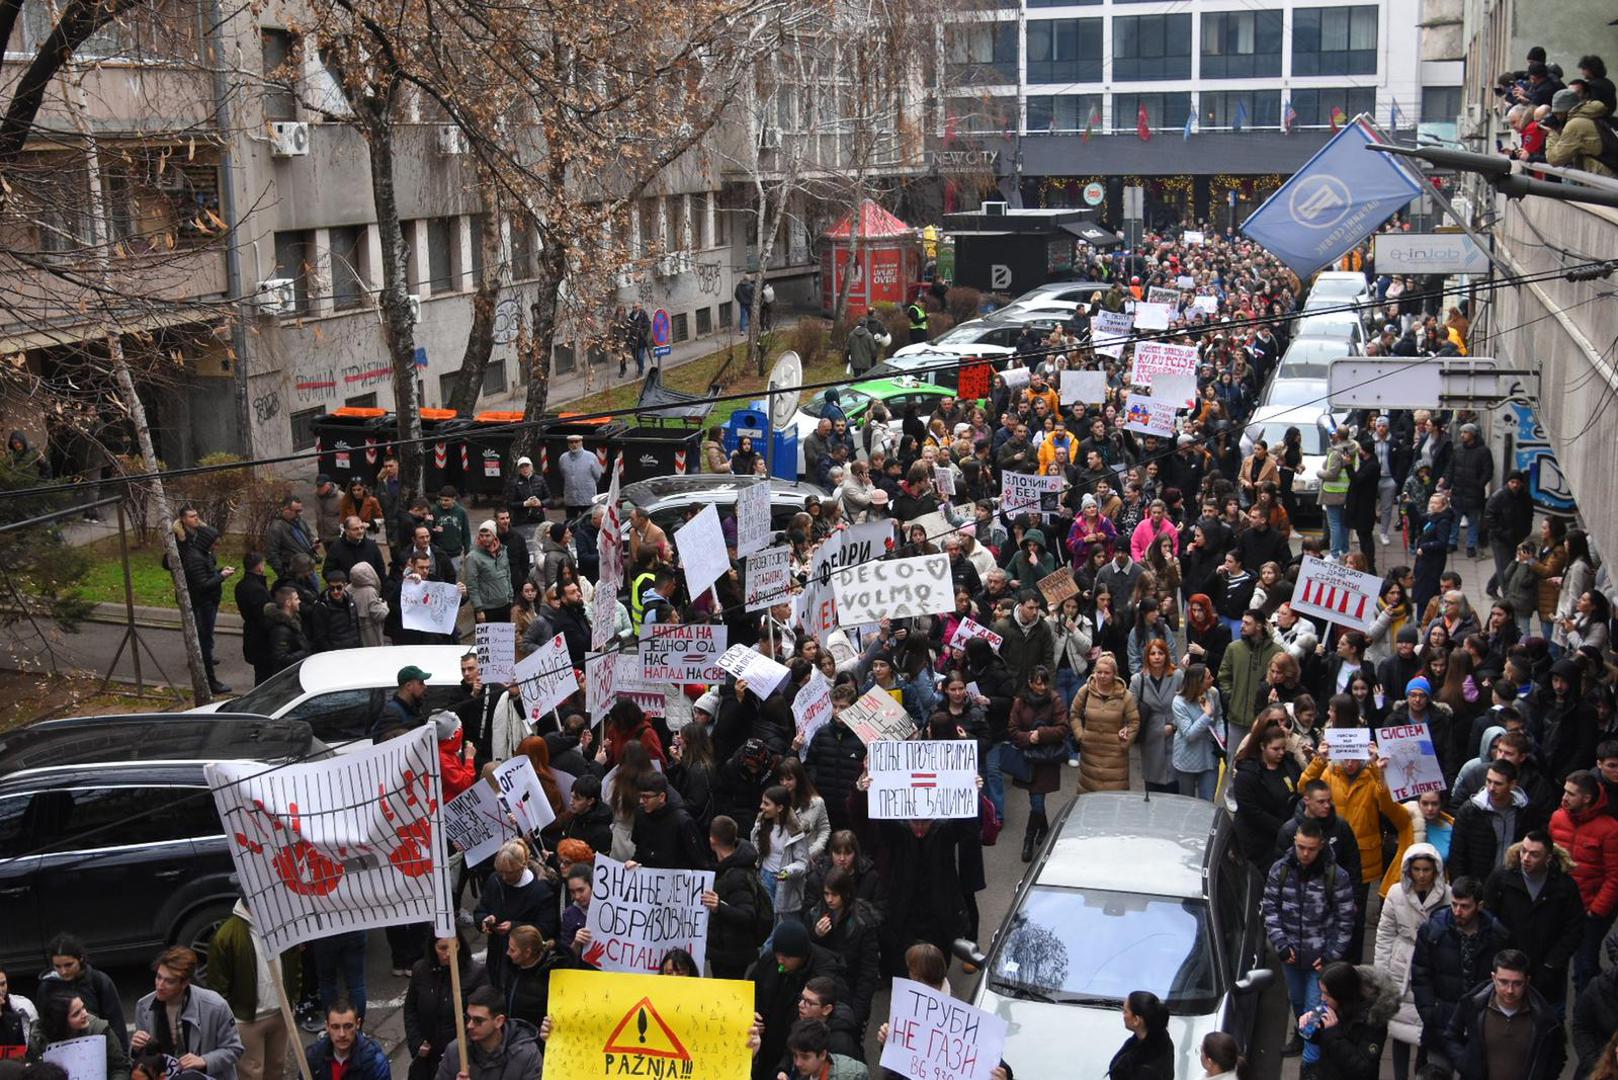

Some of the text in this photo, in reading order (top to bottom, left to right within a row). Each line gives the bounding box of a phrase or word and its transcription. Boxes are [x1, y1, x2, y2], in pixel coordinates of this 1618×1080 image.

[931, 151, 966, 165] NEW
[1138, 353, 1196, 369] KORUPCIJE
[1005, 473, 1047, 489] ЗЛОЧИН
[1016, 487, 1037, 498] БЕЗ
[1006, 495, 1038, 509] КАЗНЕ
[652, 625, 713, 640] НАПАД НА
[964, 619, 977, 632] НЕ
[645, 640, 716, 653] ЈЕДНОГ ОД
[644, 653, 669, 666] НАС
[644, 667, 684, 680] НАПАД
[686, 667, 703, 680] НА
[703, 669, 726, 681] СВЕ
[1380, 724, 1425, 740] СИСТЕМ
[868, 742, 902, 772] ПРЕТЊЕ
[1394, 780, 1443, 800] ТЕ ЛАЖЕ!
[879, 788, 975, 818] ПРЕТЊЕ ЂАЦИМА
[593, 865, 705, 907] ЗНАЊЕ ЛЕЧИ
[599, 902, 704, 942] ОБРАЗОВАЊЕ
[908, 989, 980, 1045] ТРУБИ
[892, 1016, 978, 1079] НЕ ГАЗИ
